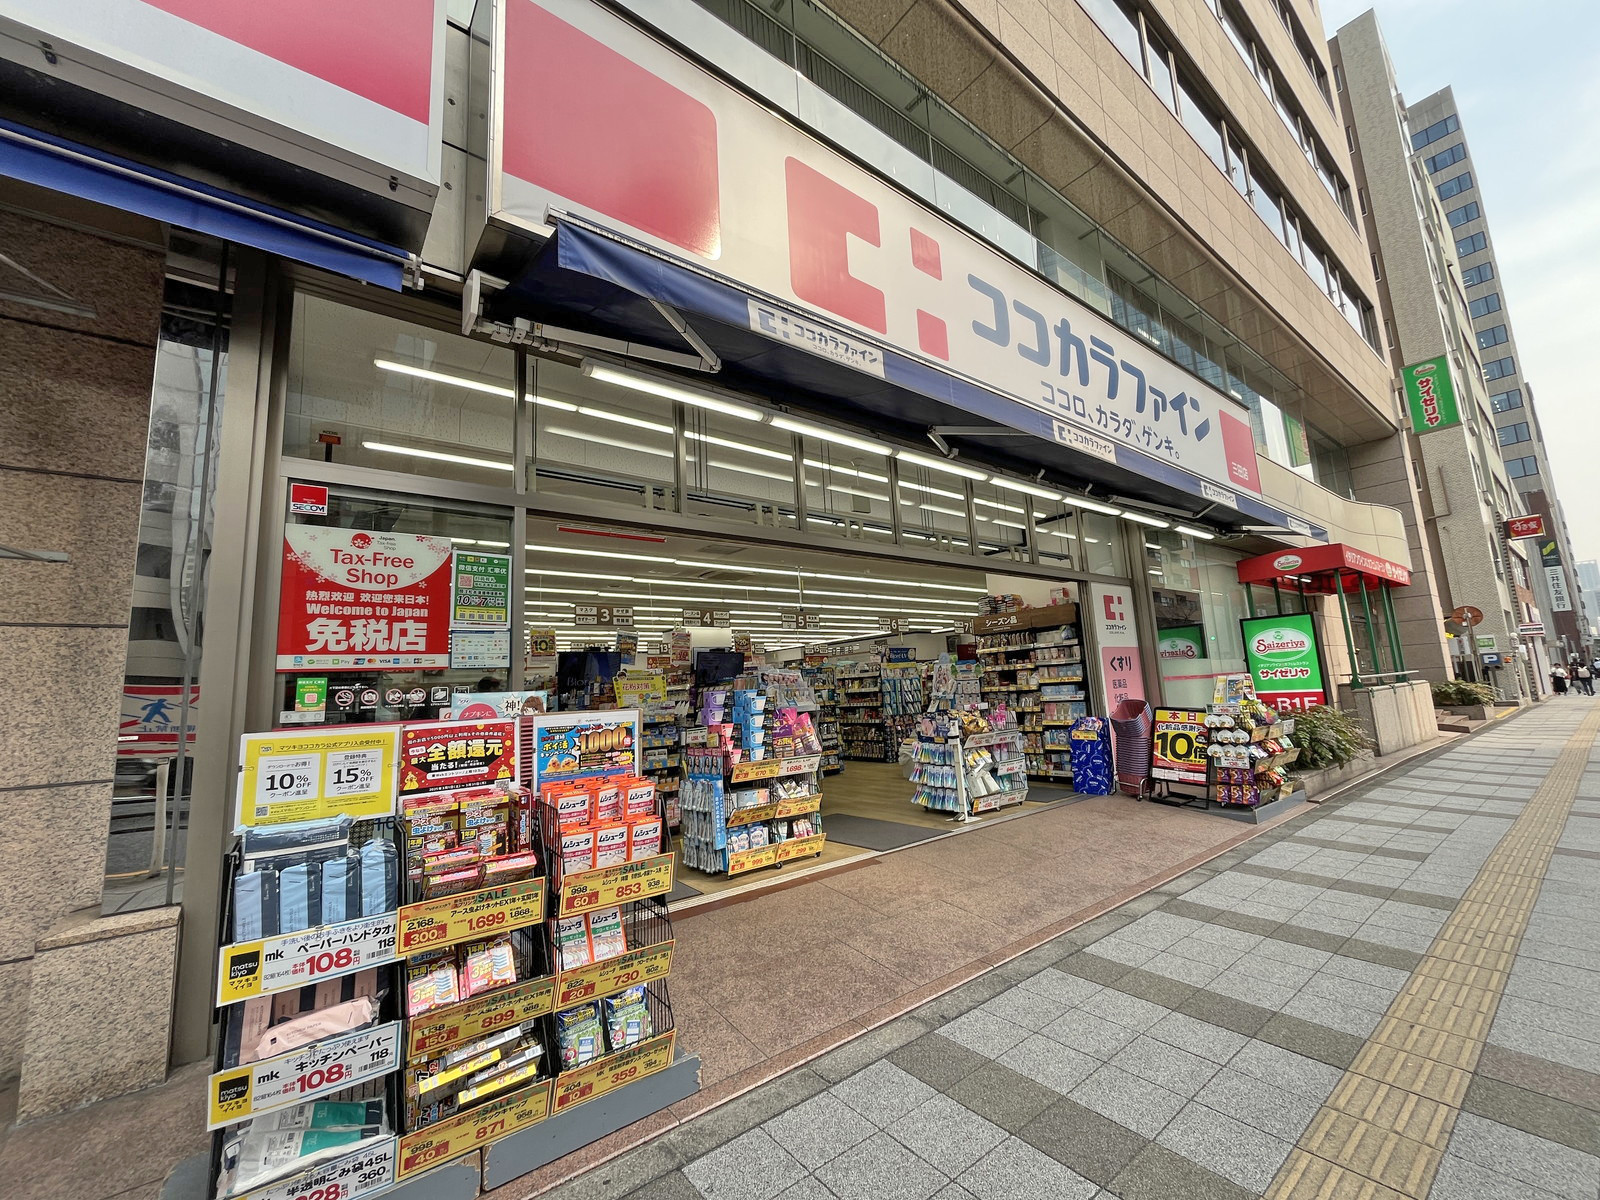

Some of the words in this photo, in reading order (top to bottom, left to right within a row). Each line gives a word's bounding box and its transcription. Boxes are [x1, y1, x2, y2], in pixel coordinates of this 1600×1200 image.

[794, 323, 878, 364] ココカラファイン
[967, 273, 1210, 442] ココカラファイン
[1418, 378, 1439, 425] サイゼリヤ
[1041, 381, 1180, 460] ココロ、カラダ、ゲンキ。
[1074, 432, 1112, 454] ココカラファイン
[1231, 462, 1249, 480] 三田店
[293, 503, 325, 513] SECOM
[1512, 521, 1539, 532] すき家
[330, 549, 415, 569] Tax-Free
[346, 568, 399, 588] Shop
[1549, 568, 1566, 609] 三井住友銀行
[306, 590, 354, 602] 热烈欢迎
[306, 603, 372, 616] Welcome
[376, 604, 389, 616] to
[391, 605, 428, 618] Japan
[600, 609, 610, 622] 3
[703, 612, 712, 624] 4
[798, 616, 805, 627] 5
[891, 619, 898, 629] 6
[985, 615, 1018, 627] シーズン品
[306, 618, 428, 652] 免税店
[1255, 639, 1306, 655] Saizeriya
[1110, 656, 1132, 671] くすり
[1483, 655, 1498, 663] P
[1260, 668, 1309, 679] サイゼリヤ
[1169, 712, 1197, 721] 本日
[543, 740, 569, 751] ポイ活
[579, 727, 627, 754] 1,000
[1155, 732, 1194, 761] 10
[427, 738, 503, 762] 全額還元
[410, 756, 426, 765] 最大
[266, 773, 294, 791] 10
[333, 767, 359, 784] 15
[629, 789, 652, 800] ムシューダ
[560, 799, 587, 810] ムシューダ
[599, 831, 626, 842] ムシューダ
[634, 826, 659, 838] ムシューダ
[563, 837, 592, 848] ムシューダ
[622, 863, 646, 875] SALE
[478, 888, 508, 903] SALE
[571, 885, 588, 896] 998
[615, 882, 642, 898] 853
[647, 880, 660, 888] 938
[574, 896, 589, 907] 60
[467, 911, 506, 932] 1,699
[592, 911, 618, 925] ムシューダ
[378, 937, 396, 949] 118
[411, 930, 438, 945] 300
[265, 949, 284, 962] mk
[306, 947, 353, 976] 108
[620, 950, 645, 965] SALE
[232, 961, 258, 971] matsu
[229, 976, 258, 986] マツキヨ
[231, 970, 247, 979] kiyo
[613, 970, 640, 986] 730
[233, 982, 252, 990] イイヨ
[567, 979, 584, 990] 822
[488, 989, 521, 1004] SALE
[570, 989, 585, 1000] 20
[481, 1009, 515, 1029] 899
[425, 1031, 448, 1047] 150
[295, 1036, 393, 1072] キッチンペーパー
[370, 1048, 389, 1061] 118
[257, 1070, 280, 1084] mk
[297, 1063, 344, 1093] 108
[611, 1066, 637, 1084] 359
[221, 1085, 247, 1096] matsu
[563, 1082, 581, 1093] 404
[220, 1093, 237, 1102] kiyo
[568, 1091, 580, 1102] 10
[218, 1098, 247, 1109] マツキヨ
[475, 1119, 505, 1139] 871
[411, 1140, 433, 1154] 998
[415, 1150, 436, 1163] 40
[358, 1166, 387, 1183] 360
